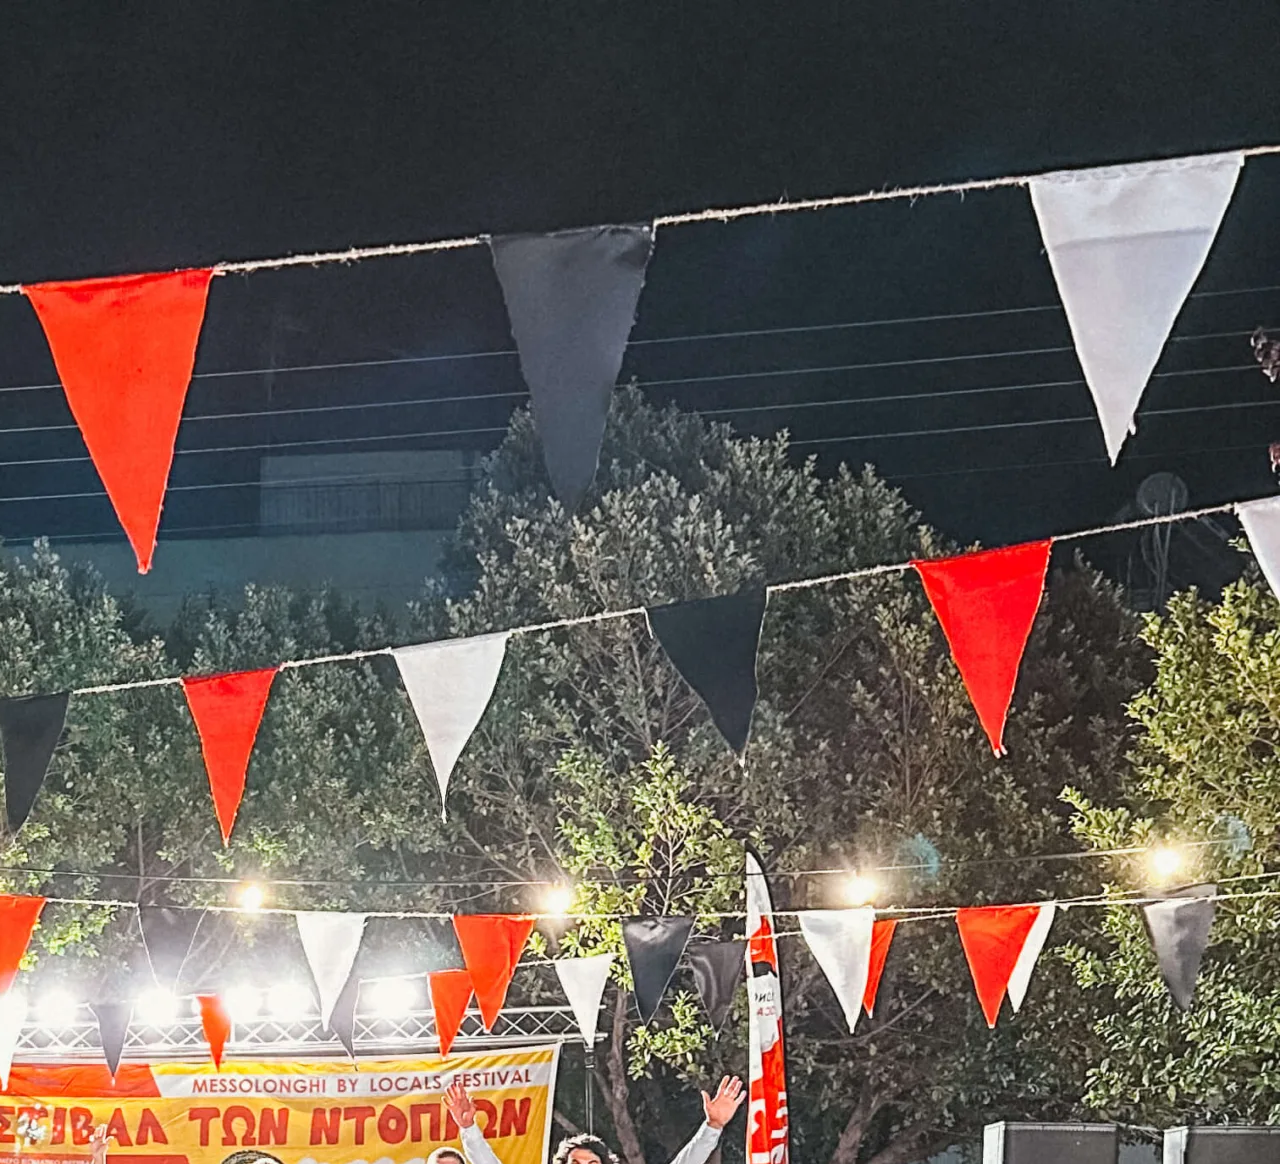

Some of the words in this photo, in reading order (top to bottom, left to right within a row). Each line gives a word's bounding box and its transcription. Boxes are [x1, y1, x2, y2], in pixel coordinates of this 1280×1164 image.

[191, 1077, 327, 1094] MESSOLONGHI
[337, 1077, 359, 1093] BY
[369, 1075, 442, 1093] LOCALS
[452, 1068, 533, 1089] FESTIVAL
[188, 1105, 290, 1146] ΤΩΝ
